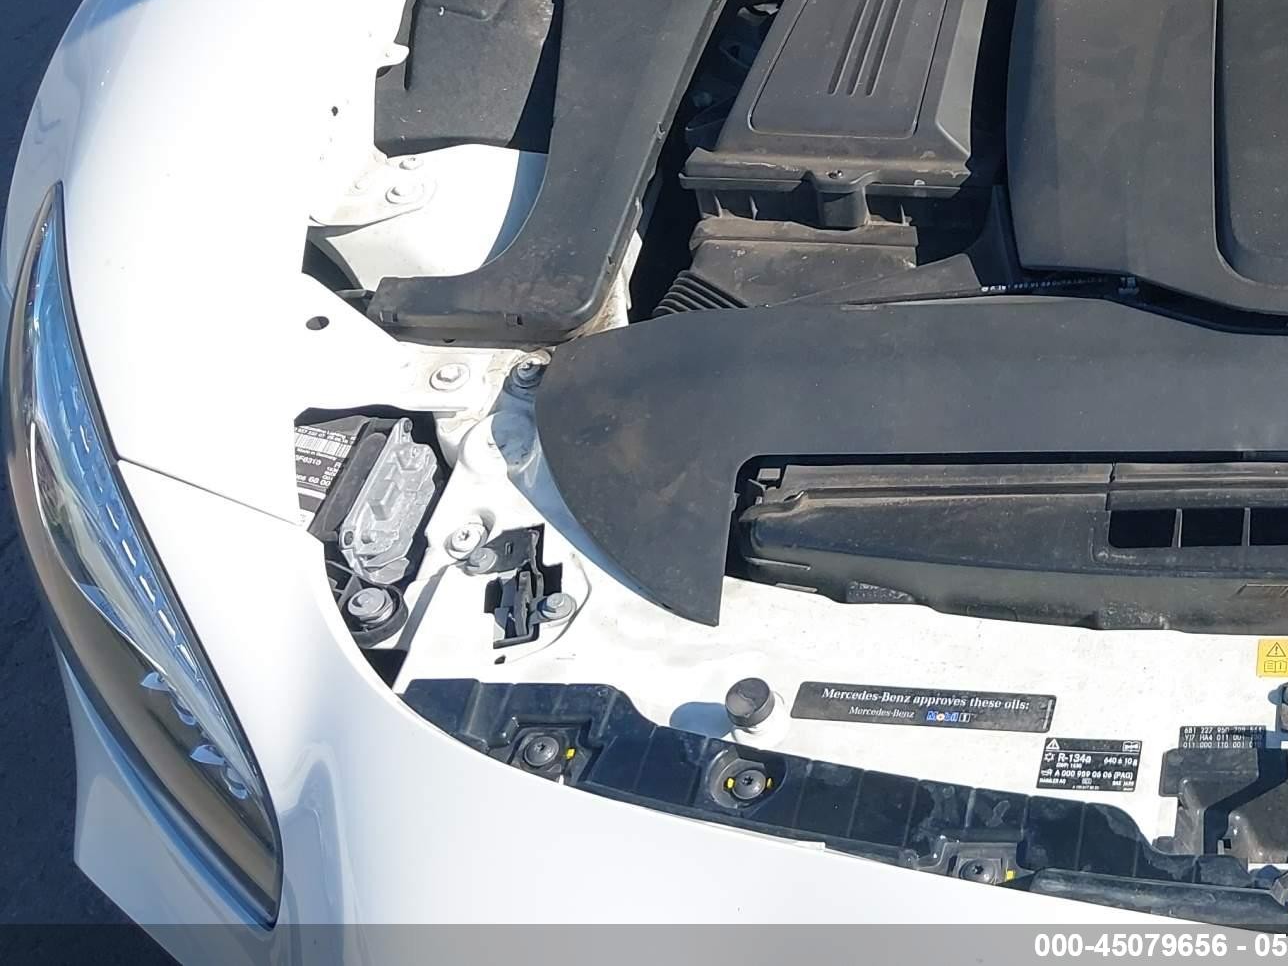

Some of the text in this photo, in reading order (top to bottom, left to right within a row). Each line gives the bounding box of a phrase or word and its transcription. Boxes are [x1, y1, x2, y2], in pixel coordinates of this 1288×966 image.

[821, 687, 1030, 710] Mercedes-Benz approves these oils:
[848, 706, 915, 719] Mercedes-Benz
[1057, 752, 1092, 763] R-134a
[1061, 769, 1075, 778] 000
